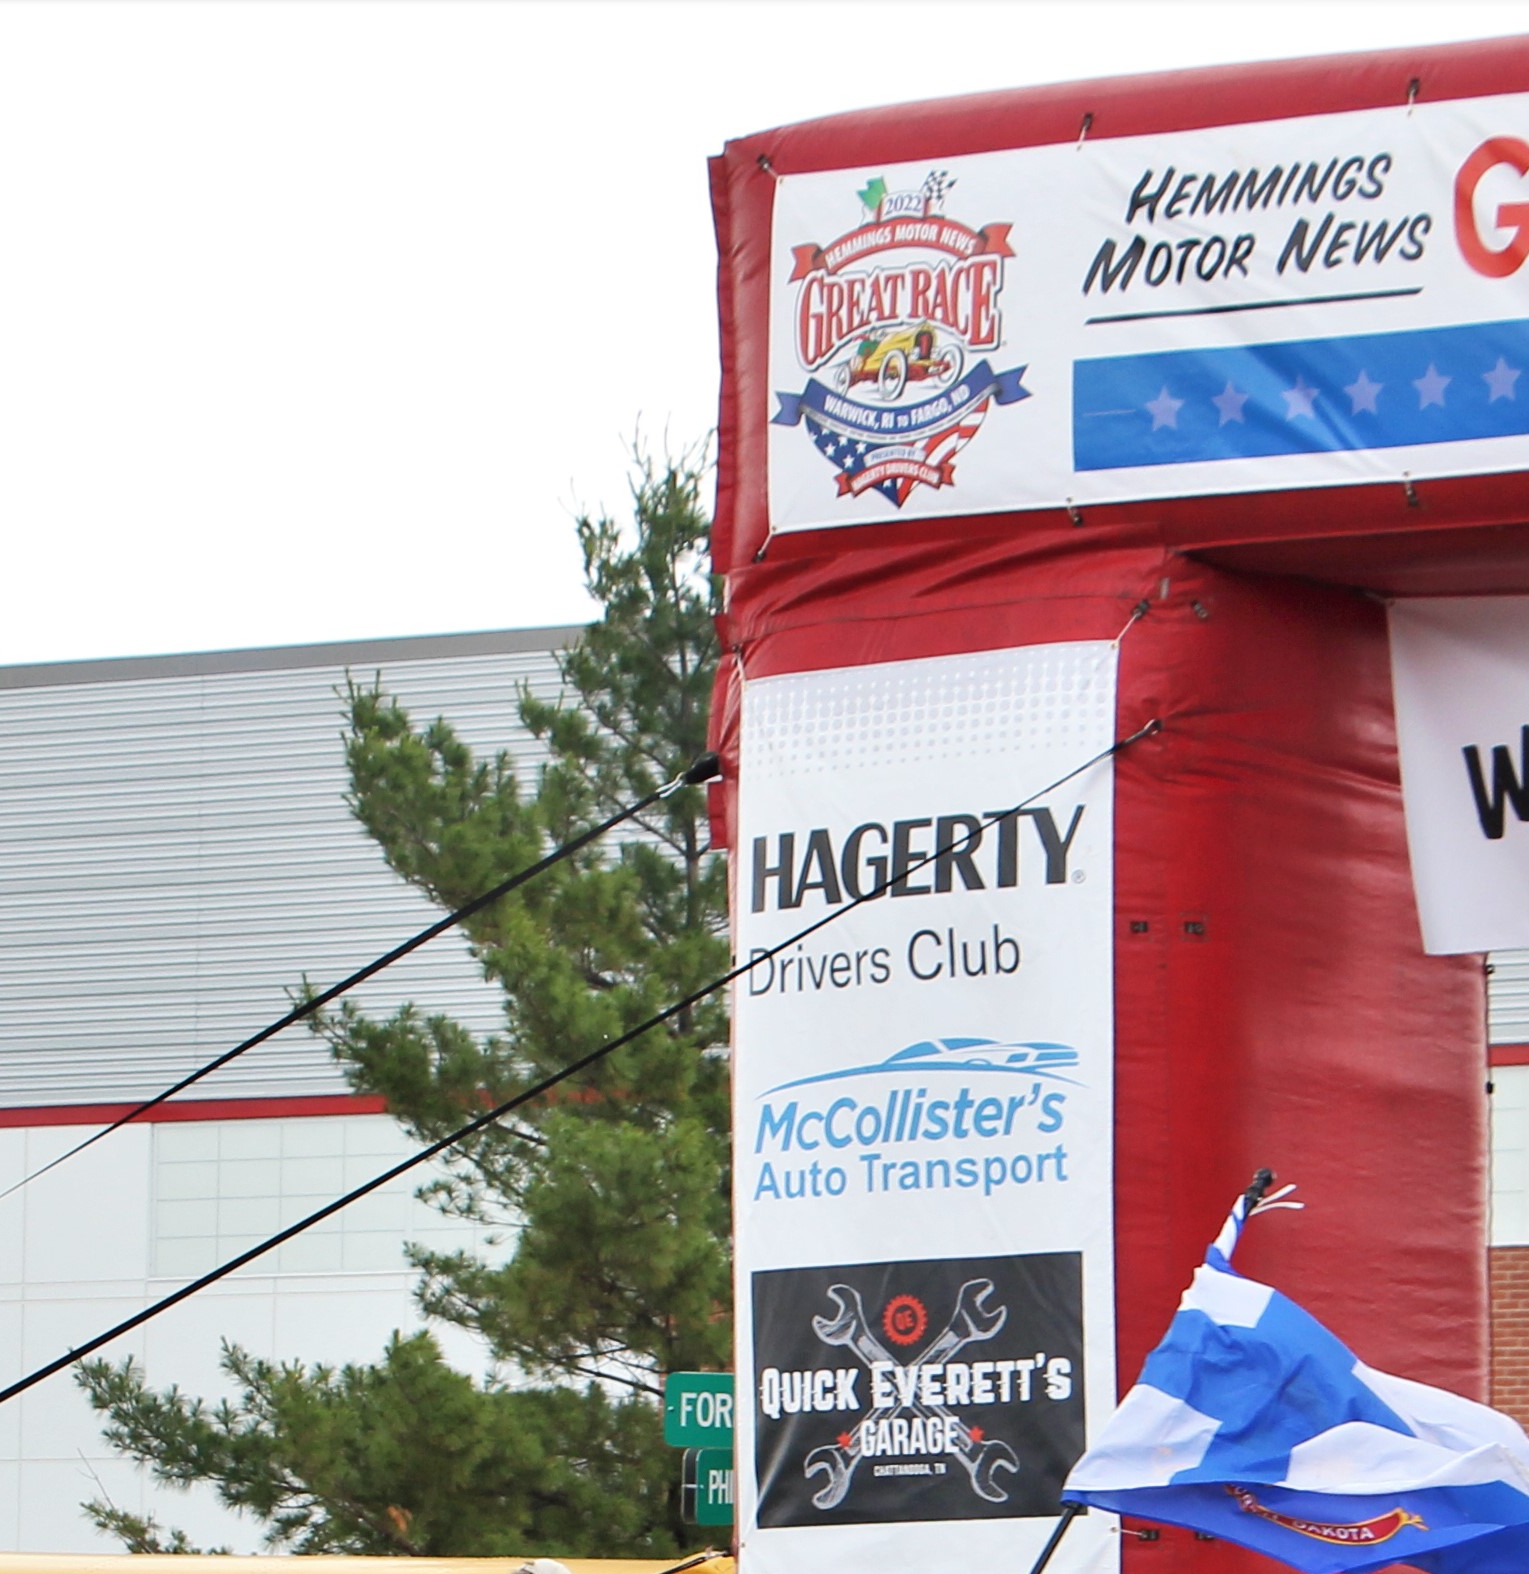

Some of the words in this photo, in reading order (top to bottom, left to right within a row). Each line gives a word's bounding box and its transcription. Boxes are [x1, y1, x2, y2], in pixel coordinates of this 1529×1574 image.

[884, 196, 923, 215] 2022
[1126, 152, 1392, 225] HEMMINGS
[825, 227, 891, 270] HEMMINGS
[895, 222, 937, 241] MOTOR
[942, 227, 977, 257] NEWS
[1082, 233, 1255, 296] MOTOR
[1276, 211, 1432, 276] NEWS
[799, 268, 905, 367] GREAT
[908, 259, 998, 348] RACE
[824, 394, 879, 430] WARWICK,
[881, 412, 894, 429] RI
[752, 804, 1085, 914] HAGERTY
[749, 944, 891, 997] Drivers
[908, 923, 1021, 981] Club
[754, 1083, 1066, 1154] McCollister's
[754, 1161, 847, 1201] Auto
[860, 1144, 1069, 1196] Transport
[760, 1365, 860, 1419] QUICK
[871, 1352, 1072, 1411] EVERETT'S
[859, 1416, 961, 1457] GARAGE
